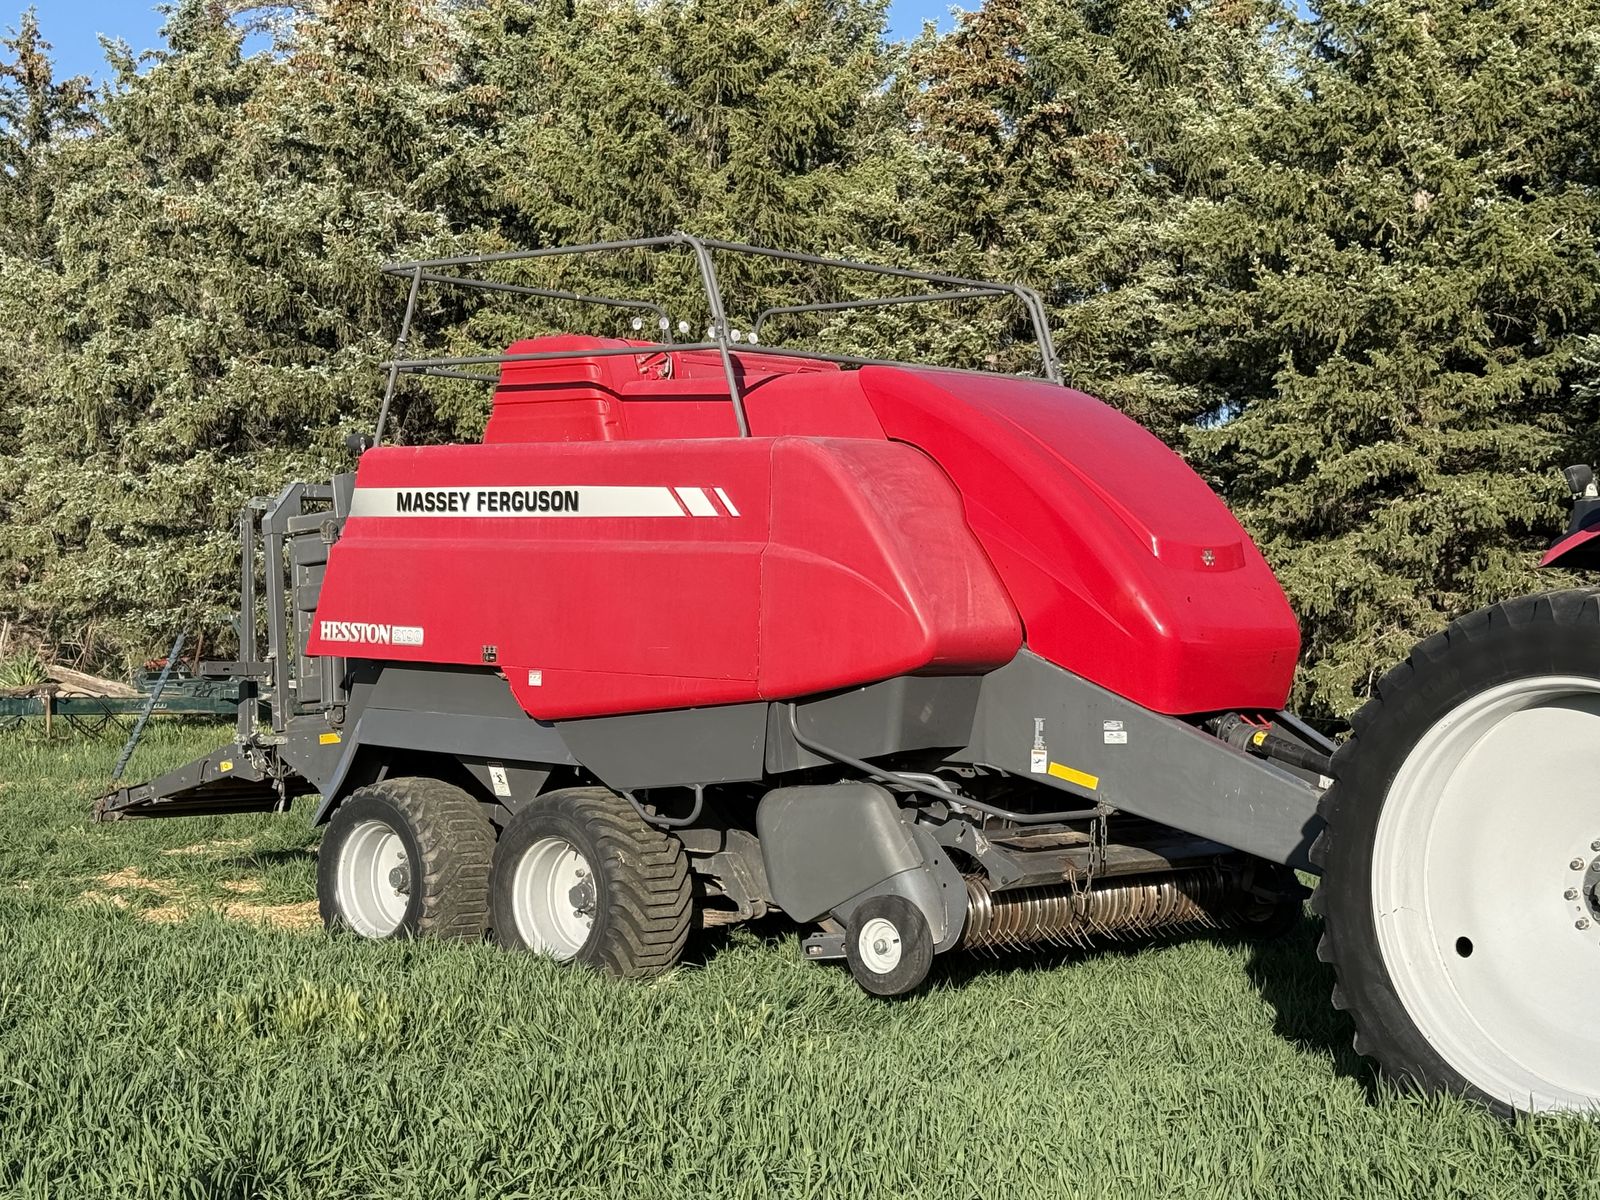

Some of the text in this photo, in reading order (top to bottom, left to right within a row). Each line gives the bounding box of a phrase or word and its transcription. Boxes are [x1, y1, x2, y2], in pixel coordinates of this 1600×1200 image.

[396, 490, 580, 512] MASSEY FERGUSON
[319, 620, 391, 645] HESSTON
